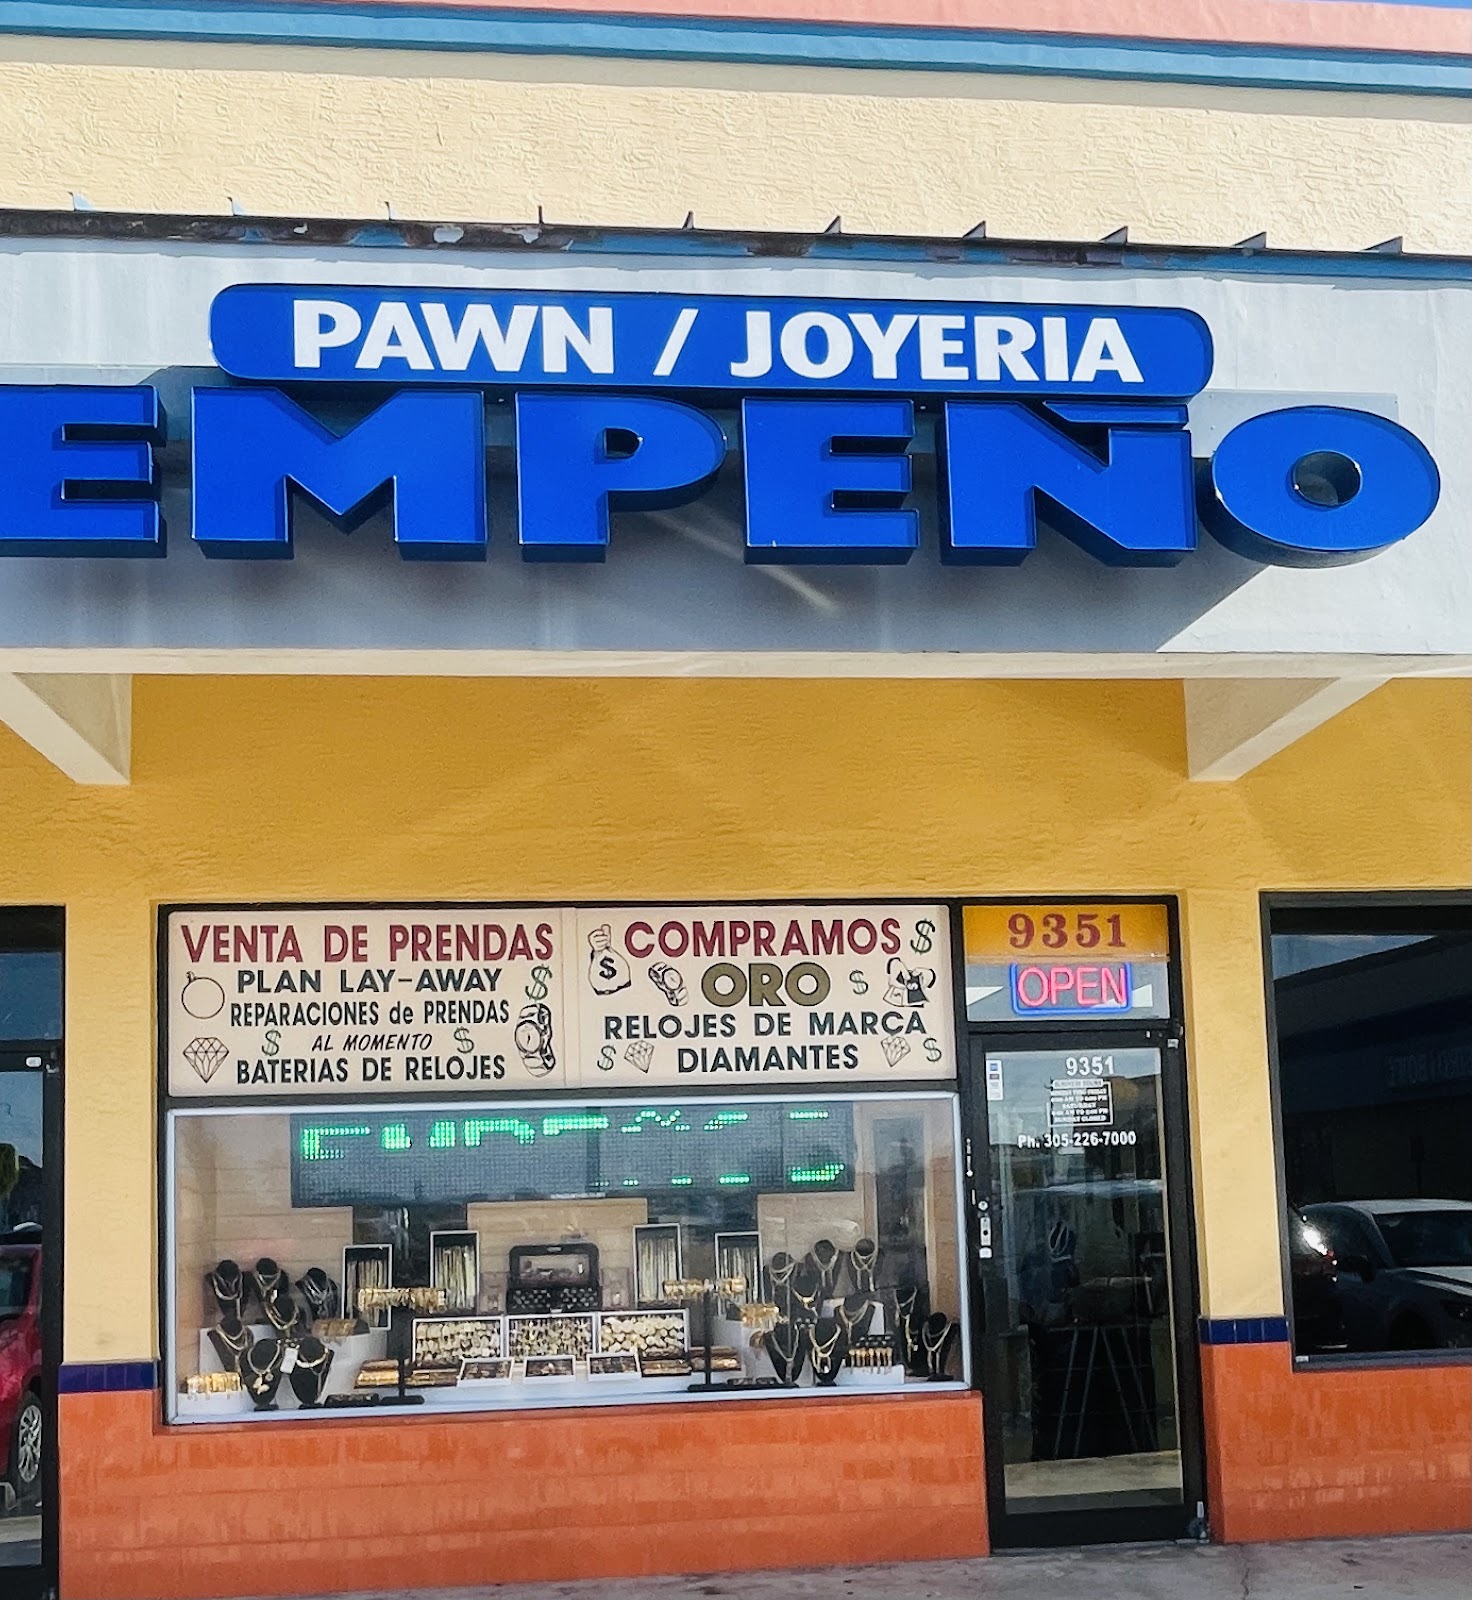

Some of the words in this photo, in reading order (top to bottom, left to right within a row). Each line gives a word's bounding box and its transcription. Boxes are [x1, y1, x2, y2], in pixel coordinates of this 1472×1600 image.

[293, 300, 614, 374] PAWN
[653, 308, 698, 377] /
[730, 310, 1144, 384] JOYERIA
[0, 384, 1441, 568] EMPEÑO
[181, 925, 304, 963] VENTA
[324, 924, 368, 962] DE
[389, 923, 553, 962] PRENDAS
[624, 917, 900, 958] COMPRAMOS
[910, 918, 935, 955] $
[1008, 912, 1126, 948] 9351
[237, 969, 321, 993] PLAN
[340, 968, 502, 993] LAY-AWAY
[525, 964, 552, 1001] $
[701, 961, 831, 1007] ORO
[849, 969, 869, 995] $
[1018, 965, 1126, 1007] OPEN
[230, 1001, 379, 1027] REPARACIONES
[388, 1001, 414, 1025] de
[424, 1000, 509, 1024] PRENDAS
[604, 1012, 736, 1040] RELOJES
[754, 1012, 792, 1037] DE
[809, 1010, 926, 1035] MARCA
[261, 1029, 282, 1057] $
[311, 1035, 333, 1052] AL
[343, 1032, 433, 1051] MOMENTO
[453, 1026, 475, 1054] $
[923, 1037, 942, 1062] $
[237, 1057, 348, 1084] BATERIAS
[362, 1056, 391, 1081] DE
[405, 1054, 506, 1080] RELOJES
[597, 1045, 617, 1071] $
[677, 1044, 858, 1073] DIAMANTES
[1065, 1055, 1115, 1076] 9351
[1018, 1134, 1040, 1148] Ph.
